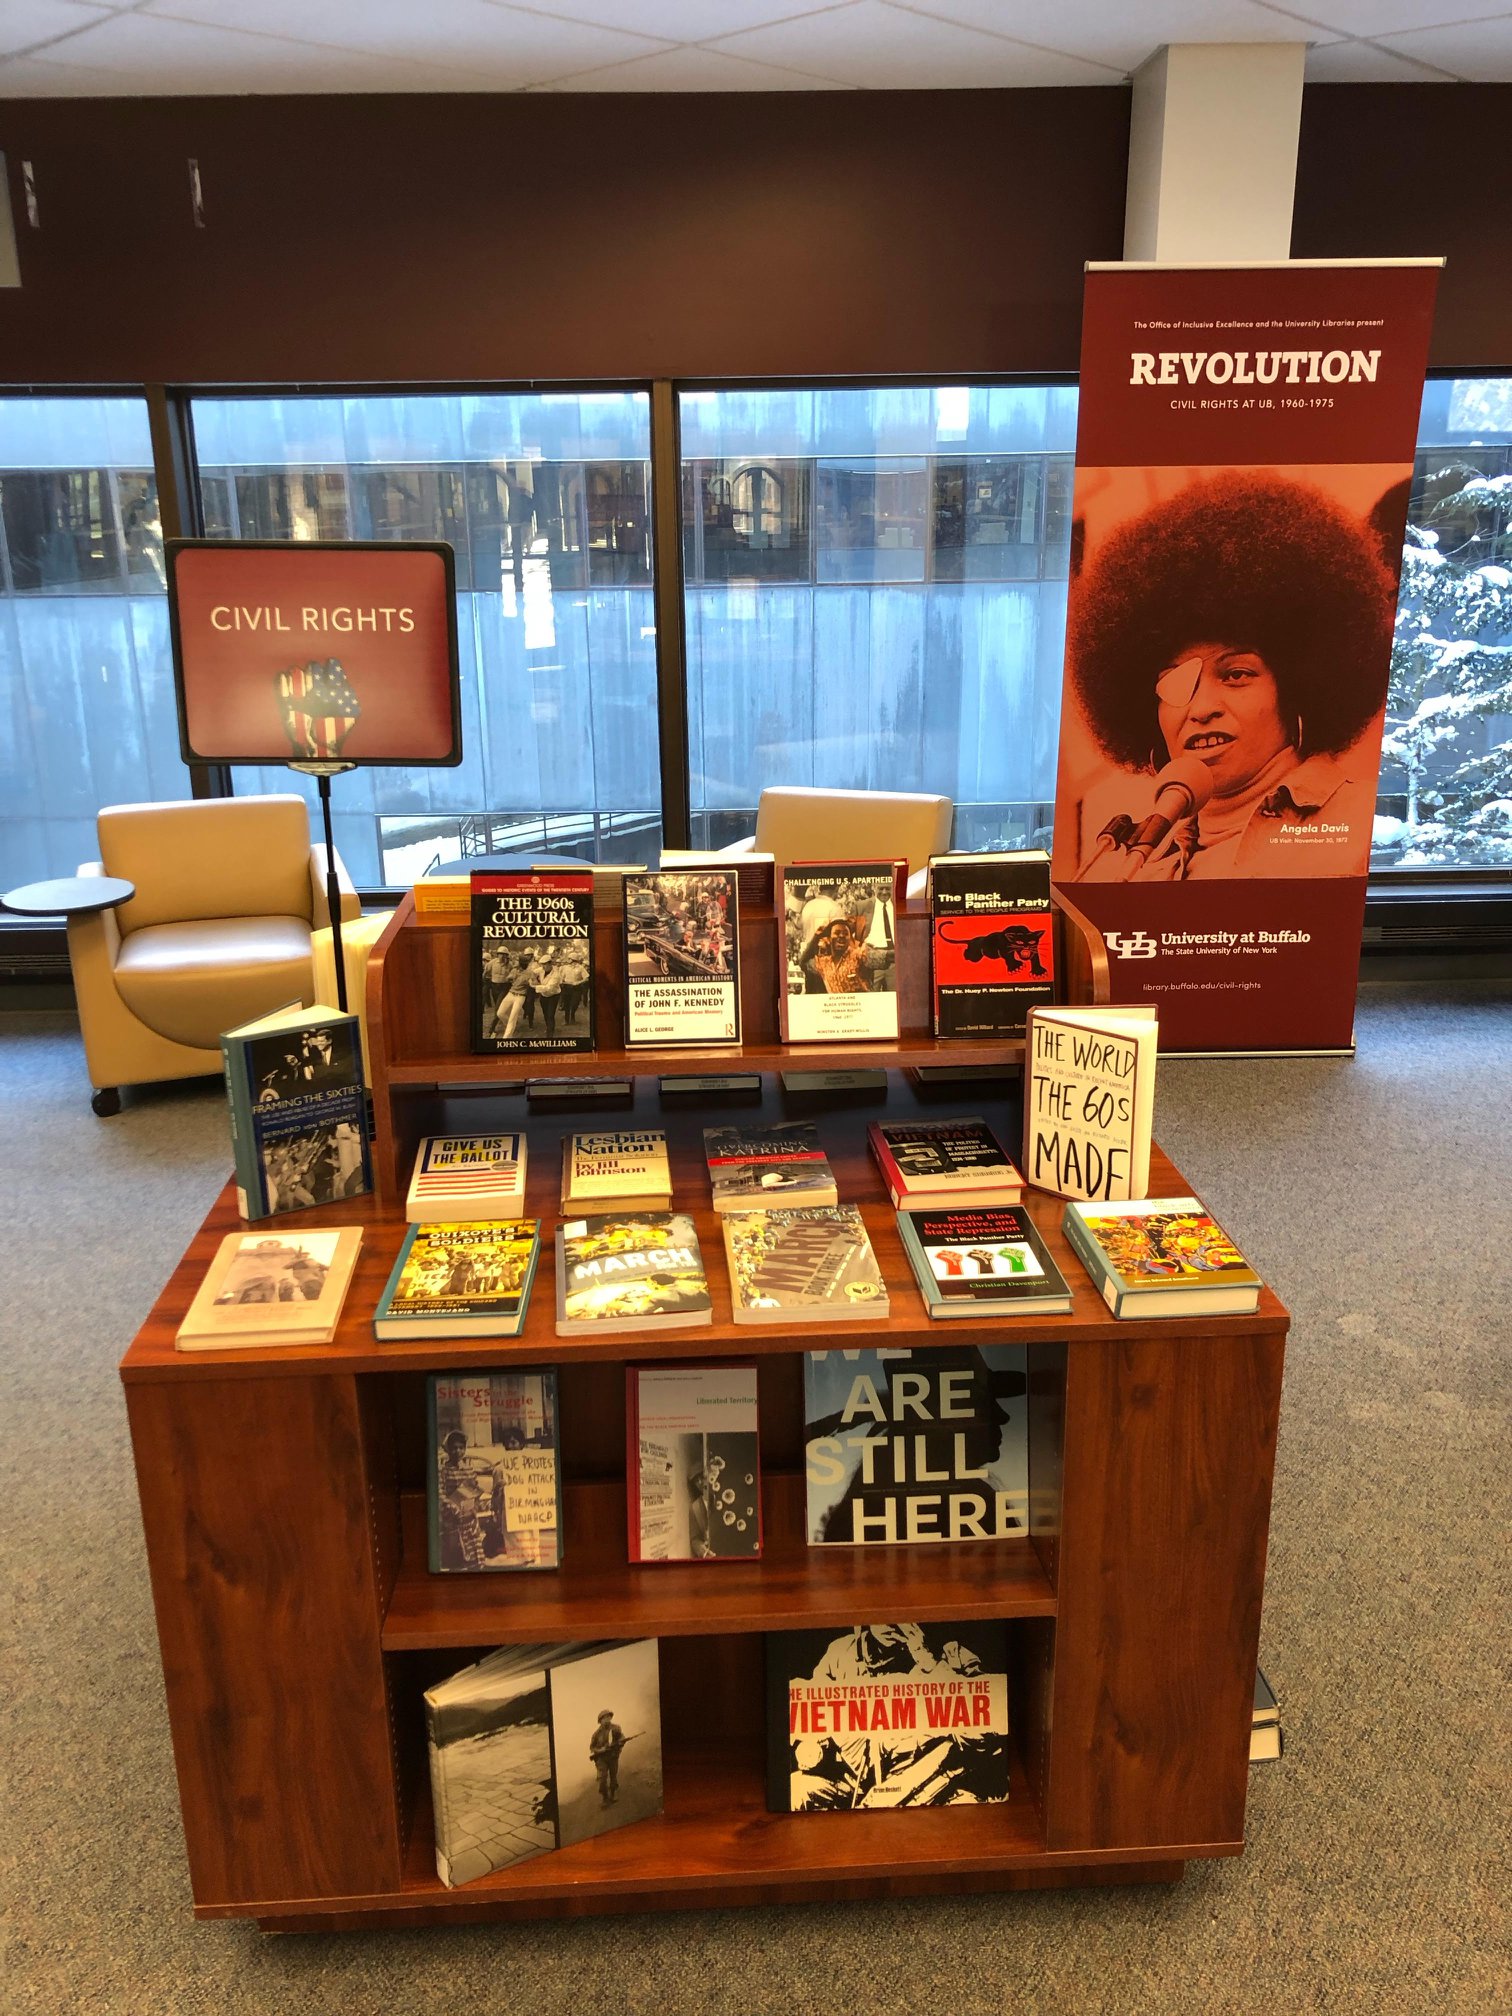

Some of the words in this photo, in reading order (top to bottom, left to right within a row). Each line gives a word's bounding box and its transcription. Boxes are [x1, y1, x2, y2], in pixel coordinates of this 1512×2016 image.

[1134, 321, 1147, 329] The
[1150, 321, 1171, 329] Office
[1173, 321, 1181, 329] of
[1216, 320, 1253, 328] Excellence
[1285, 320, 1320, 328] University
[1322, 319, 1354, 327] Libraries
[1356, 319, 1384, 328] present
[1129, 350, 1382, 385] REVOLUTION
[1170, 400, 1197, 409] CIVIL
[1200, 399, 1239, 409] RIGHTS
[1242, 399, 1255, 409] AT
[1258, 399, 1276, 409] UB,
[1281, 398, 1334, 408] 1960-1975
[210, 606, 291, 631] CIVIL
[302, 606, 415, 632] RIGHTS
[1280, 823, 1318, 836] Angela
[1321, 822, 1350, 832] Davis
[783, 877, 835, 887] CHALLENGING
[836, 877, 851, 885] U.S.
[852, 876, 893, 885] APARTHEID
[496, 897, 532, 910] THE
[536, 897, 575, 910] 1960s
[938, 894, 961, 902] The
[965, 892, 1001, 901] Black
[965, 899, 1014, 909] Panther
[1016, 898, 1049, 908] Party
[491, 911, 580, 924] CULTURAL
[482, 925, 589, 938] REVOLUTION
[1103, 931, 1157, 959] UB
[1161, 930, 1239, 947] University
[1240, 931, 1255, 943] at
[1258, 930, 1311, 943] Buffalo
[1161, 948, 1174, 956] The
[1196, 947, 1231, 956] University
[1233, 946, 1241, 954] of
[1261, 946, 1278, 954] York
[634, 989, 651, 998] THE
[653, 987, 723, 997] ASSASSINATION
[1143, 982, 1262, 992] library.buffalo.edu/civil-rights
[634, 1000, 646, 1009] OF
[648, 1000, 671, 1008] JOHN
[674, 999, 681, 1007] F.
[684, 998, 725, 1007] KENNEDY
[496, 1040, 518, 1049] JOHN
[1033, 1025, 1065, 1062] THE
[1073, 1035, 1136, 1078] WORLD
[252, 1096, 303, 1114] FRAMING
[303, 1092, 325, 1104] THE
[326, 1084, 363, 1100] SIXTIES
[1033, 1076, 1077, 1121] THE
[262, 1125, 302, 1139] BERNARD
[319, 1113, 357, 1127] BOTHMER
[442, 1140, 478, 1151] GIVE
[482, 1139, 503, 1150] US
[574, 1133, 666, 1146] Lesbian
[574, 1143, 654, 1156] Nation
[720, 1145, 809, 1157] KATRINA
[433, 1153, 457, 1164] THE
[460, 1149, 510, 1163] BALLOT
[574, 1166, 647, 1178] Johnston
[575, 1161, 594, 1171] by
[597, 1160, 619, 1170] Jill
[923, 1220, 993, 1230] Perspective,
[994, 1218, 1018, 1226] and
[946, 1214, 983, 1222] Media
[923, 1228, 954, 1236] State
[956, 1226, 1021, 1235] Repression
[430, 1234, 515, 1247] SOLDIERS
[574, 1247, 698, 1280] MARCH
[817, 1252, 845, 1274] THREE
[969, 1281, 1007, 1289] Christian
[1007, 1279, 1050, 1287] Davenport
[437, 1386, 492, 1400] Sisters
[840, 1370, 976, 1423] ARE
[473, 1395, 534, 1408] Struggle
[696, 1397, 728, 1405] Liberated
[522, 1455, 556, 1470] PROTES
[805, 1432, 989, 1486] STILL
[852, 1490, 1029, 1543] HERE
[790, 1688, 802, 1700] HE
[806, 1685, 890, 1700] ILLUSTRATED
[893, 1682, 946, 1697] HISTORY
[949, 1682, 964, 1695] OF
[967, 1681, 990, 1694] THE
[790, 1698, 917, 1734] VIETNAM
[925, 1694, 991, 1728] WAR
